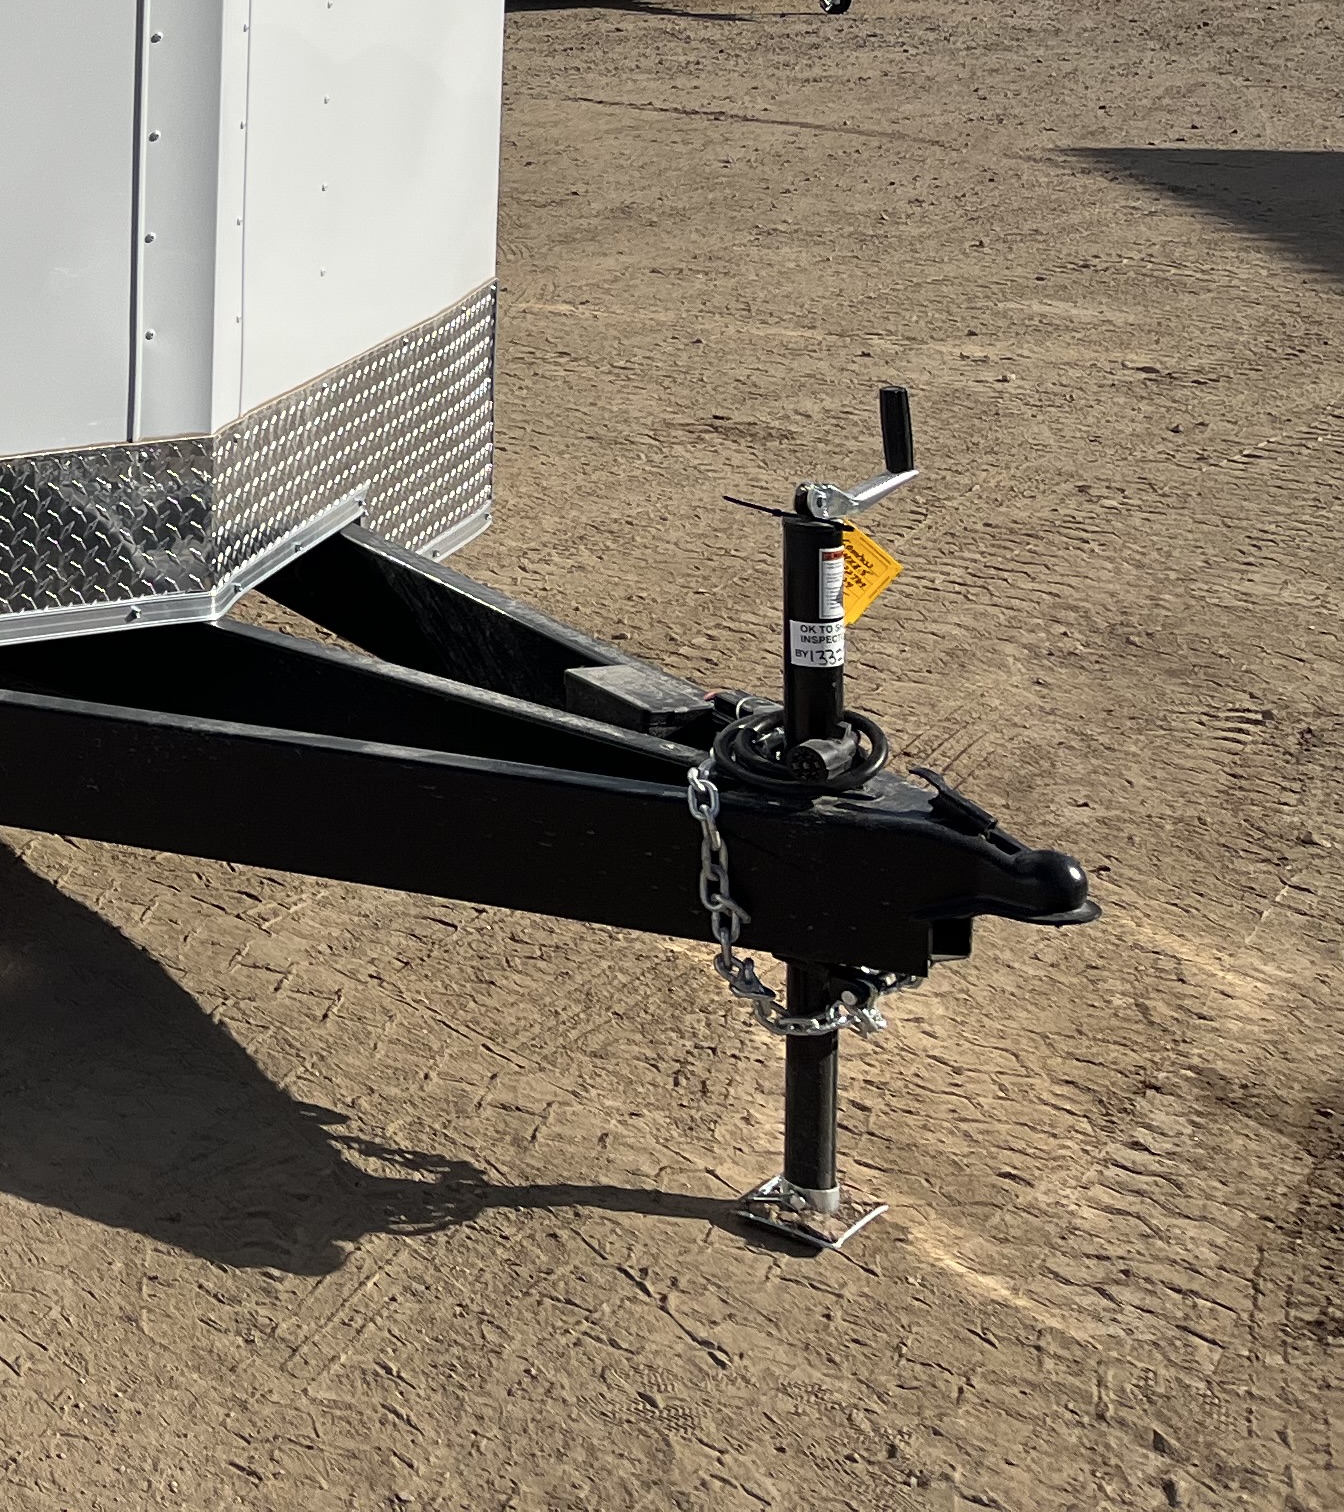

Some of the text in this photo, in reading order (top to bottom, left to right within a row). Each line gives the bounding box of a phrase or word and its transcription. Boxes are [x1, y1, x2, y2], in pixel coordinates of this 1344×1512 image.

[800, 624, 817, 635] OK
[819, 625, 833, 634] TO
[795, 648, 809, 658] BY
